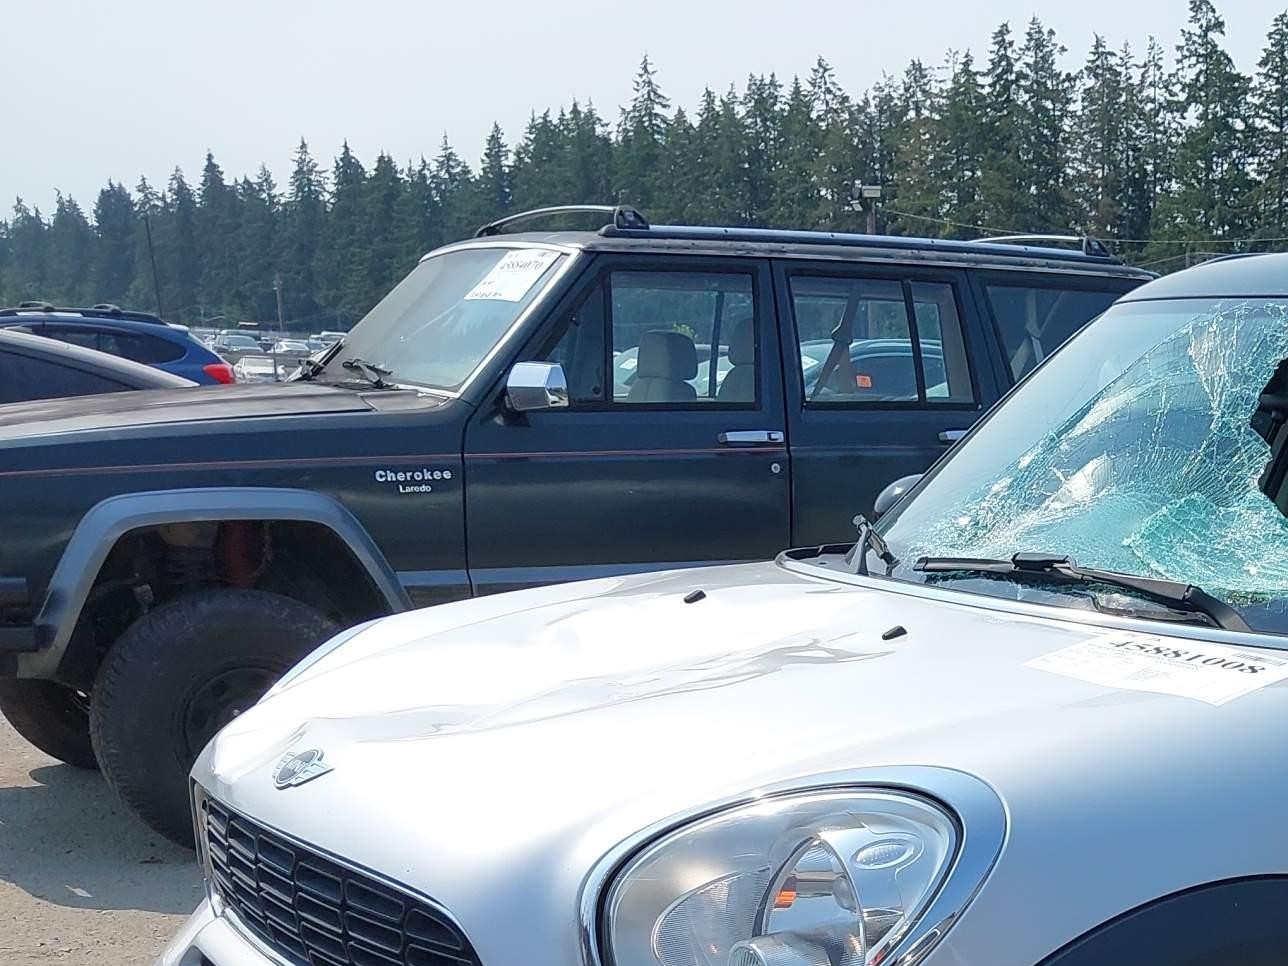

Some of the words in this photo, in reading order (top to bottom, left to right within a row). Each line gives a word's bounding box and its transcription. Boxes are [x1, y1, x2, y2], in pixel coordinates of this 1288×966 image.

[375, 468, 452, 482] Cherokee
[399, 484, 432, 493] Laredo
[1109, 640, 1265, 674] 45881008
